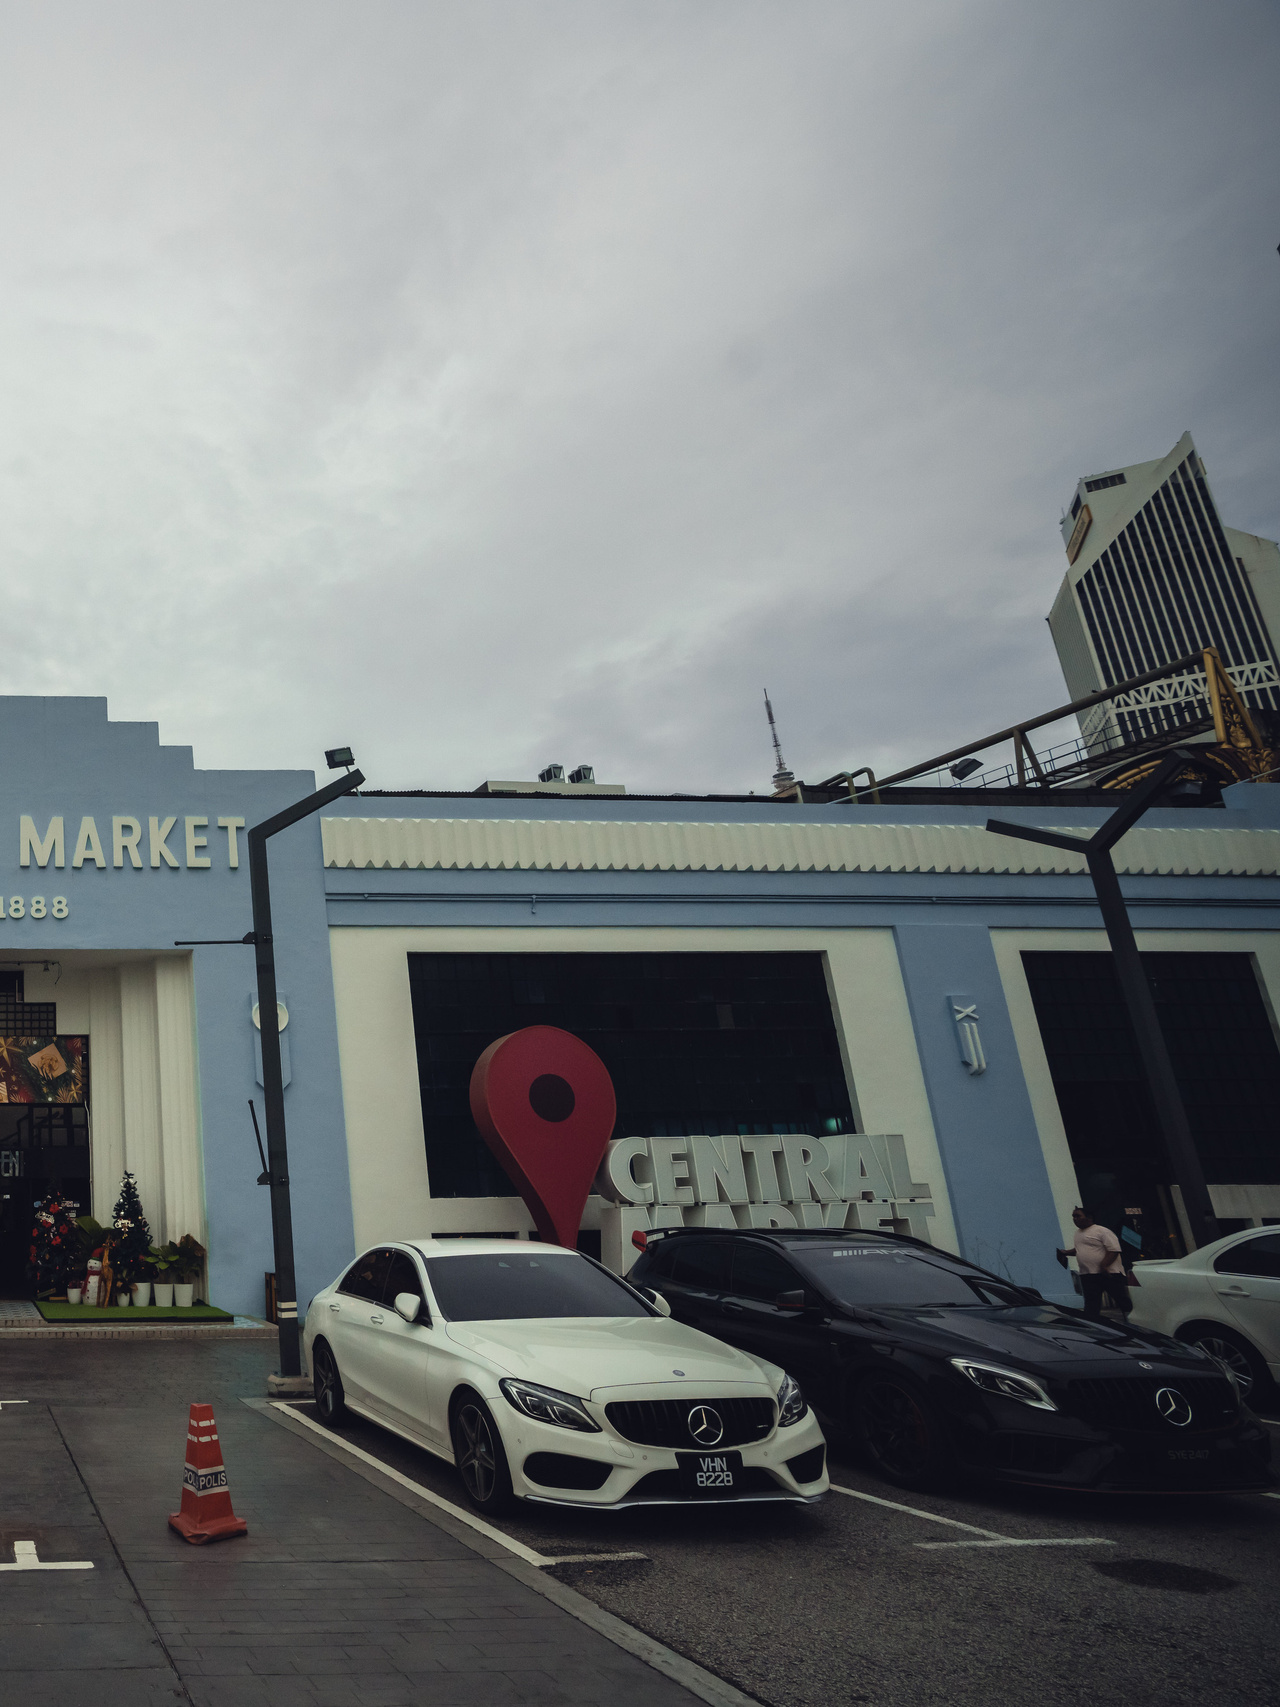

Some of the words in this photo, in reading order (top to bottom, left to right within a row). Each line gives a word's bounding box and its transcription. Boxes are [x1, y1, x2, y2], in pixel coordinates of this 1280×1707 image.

[20, 815, 246, 869] MARKET
[600, 1134, 932, 1204] CENTRAL
[699, 1457, 728, 1472] VHN
[199, 1472, 227, 1489] POLIS
[696, 1471, 734, 1487] 8228
